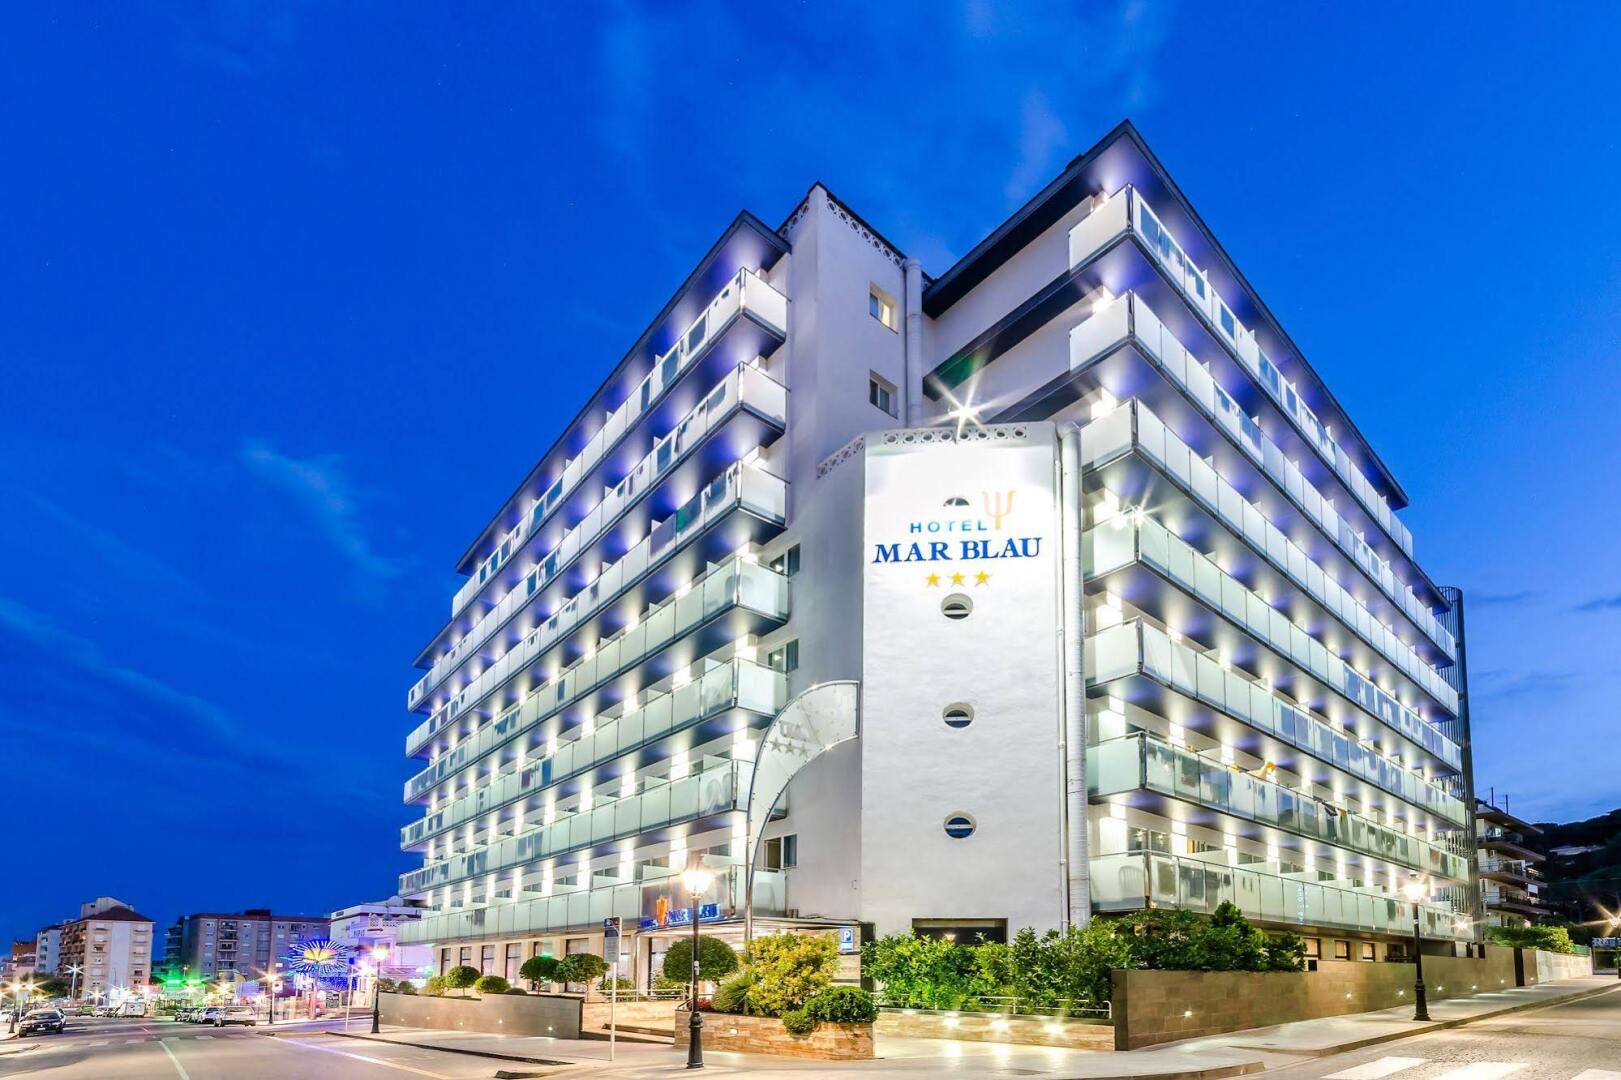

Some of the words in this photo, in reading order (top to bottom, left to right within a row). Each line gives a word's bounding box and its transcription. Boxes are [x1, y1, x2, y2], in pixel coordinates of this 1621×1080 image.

[909, 520, 988, 533] HOTEL
[872, 541, 953, 563] MAR
[959, 537, 1043, 560] BLAU
[843, 930, 850, 941] P
